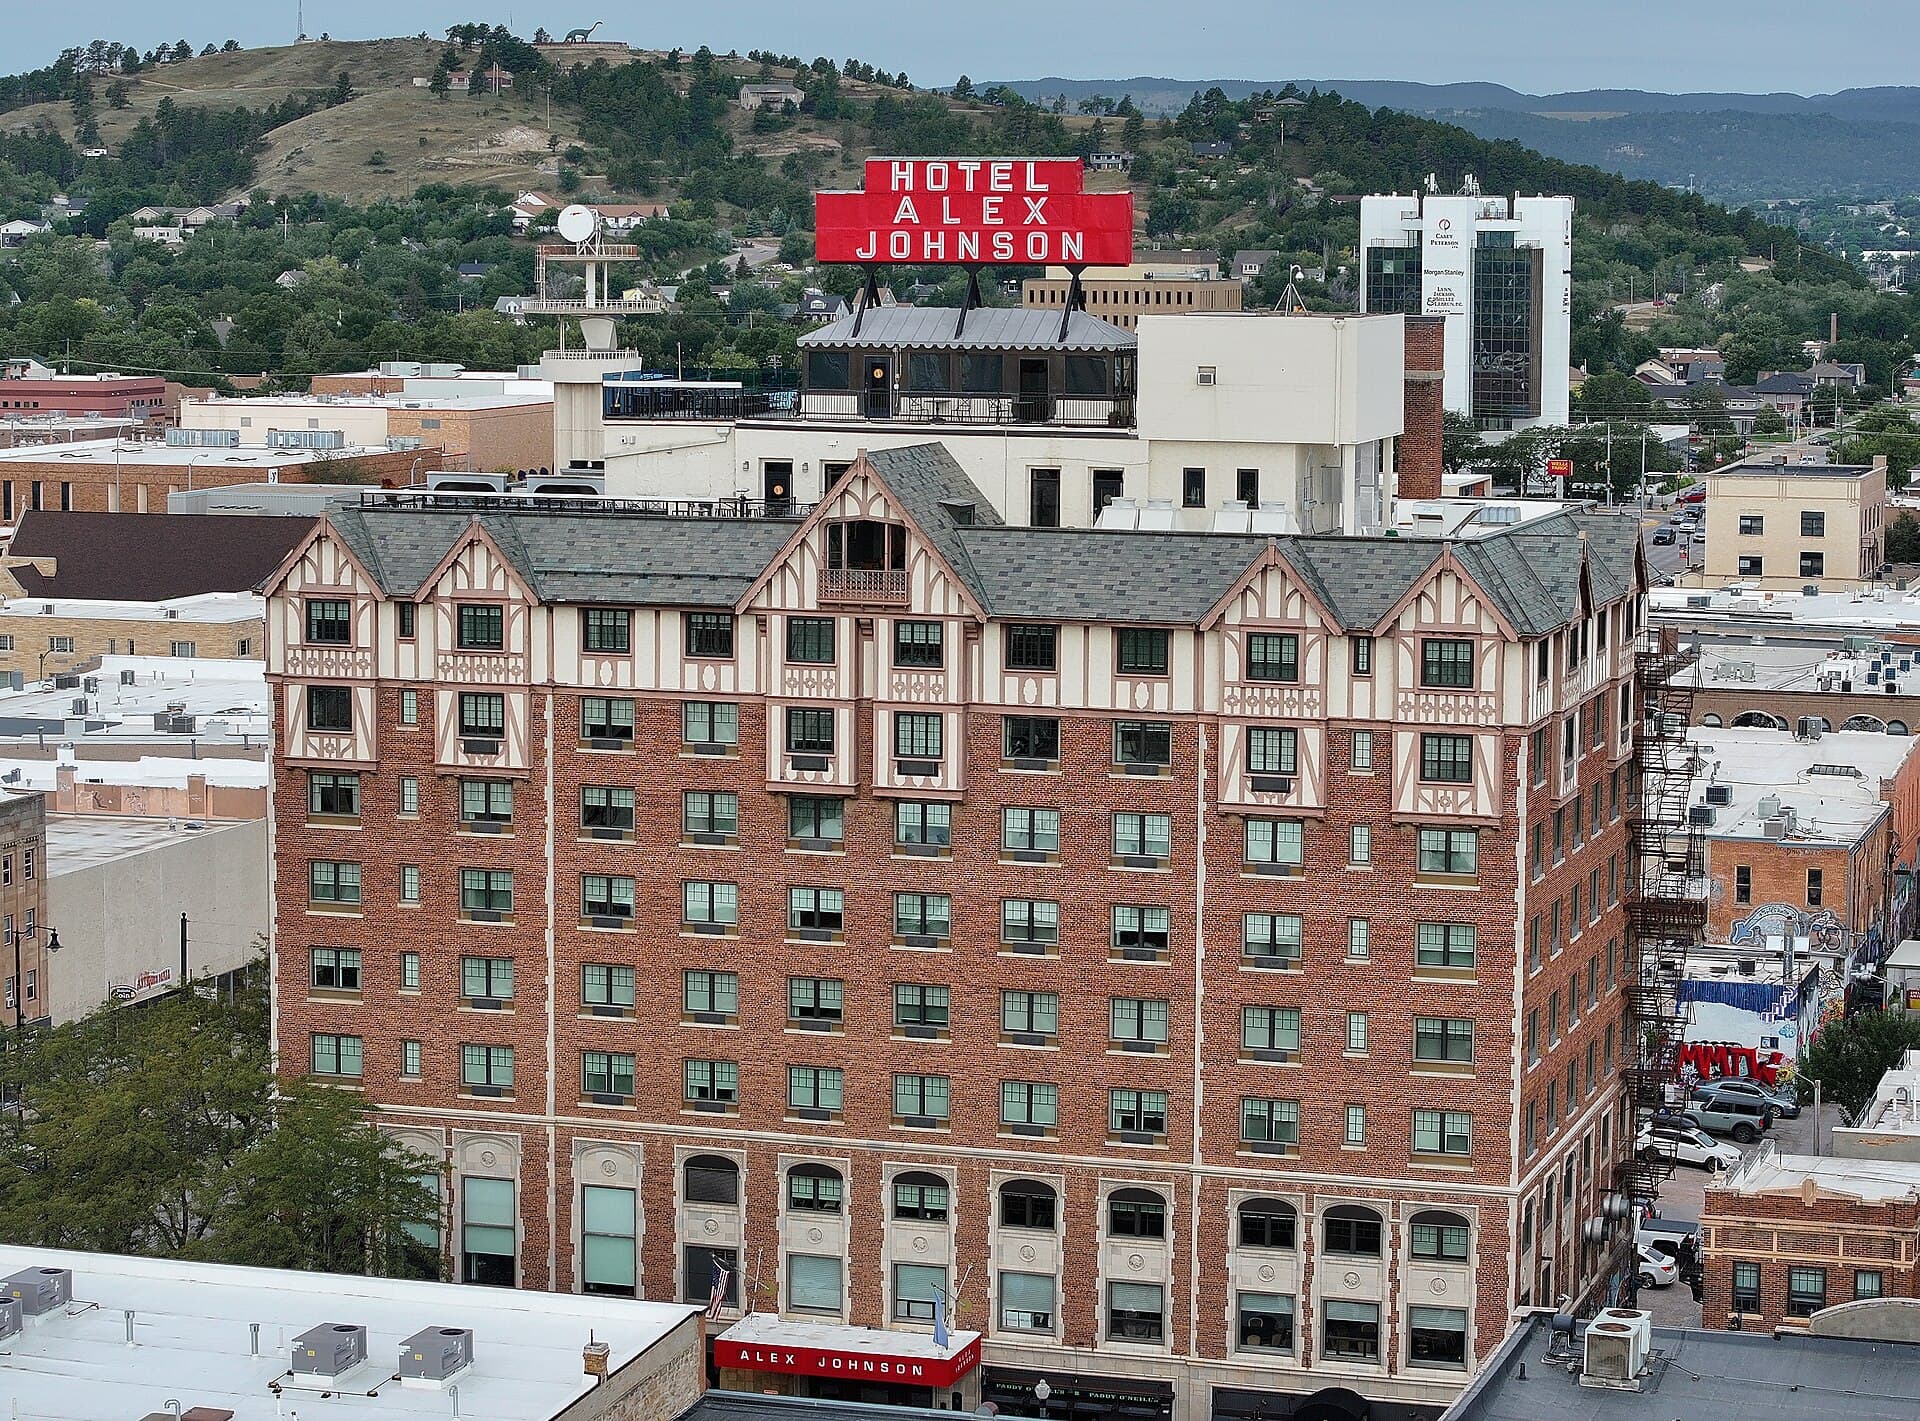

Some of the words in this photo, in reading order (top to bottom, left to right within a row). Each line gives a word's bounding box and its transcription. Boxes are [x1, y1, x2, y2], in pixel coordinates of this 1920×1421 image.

[891, 161, 1049, 192] HOTEL
[893, 195, 1049, 225] ALEX
[855, 230, 1084, 261] JOHNSON
[1424, 269, 1444, 277] Morgan
[1444, 269, 1465, 277] Stanley
[740, 1350, 795, 1365] ALEX
[818, 1356, 924, 1376] JOHNSON
[996, 1383, 1023, 1391] PADDY
[1089, 1392, 1116, 1400] PADDY
